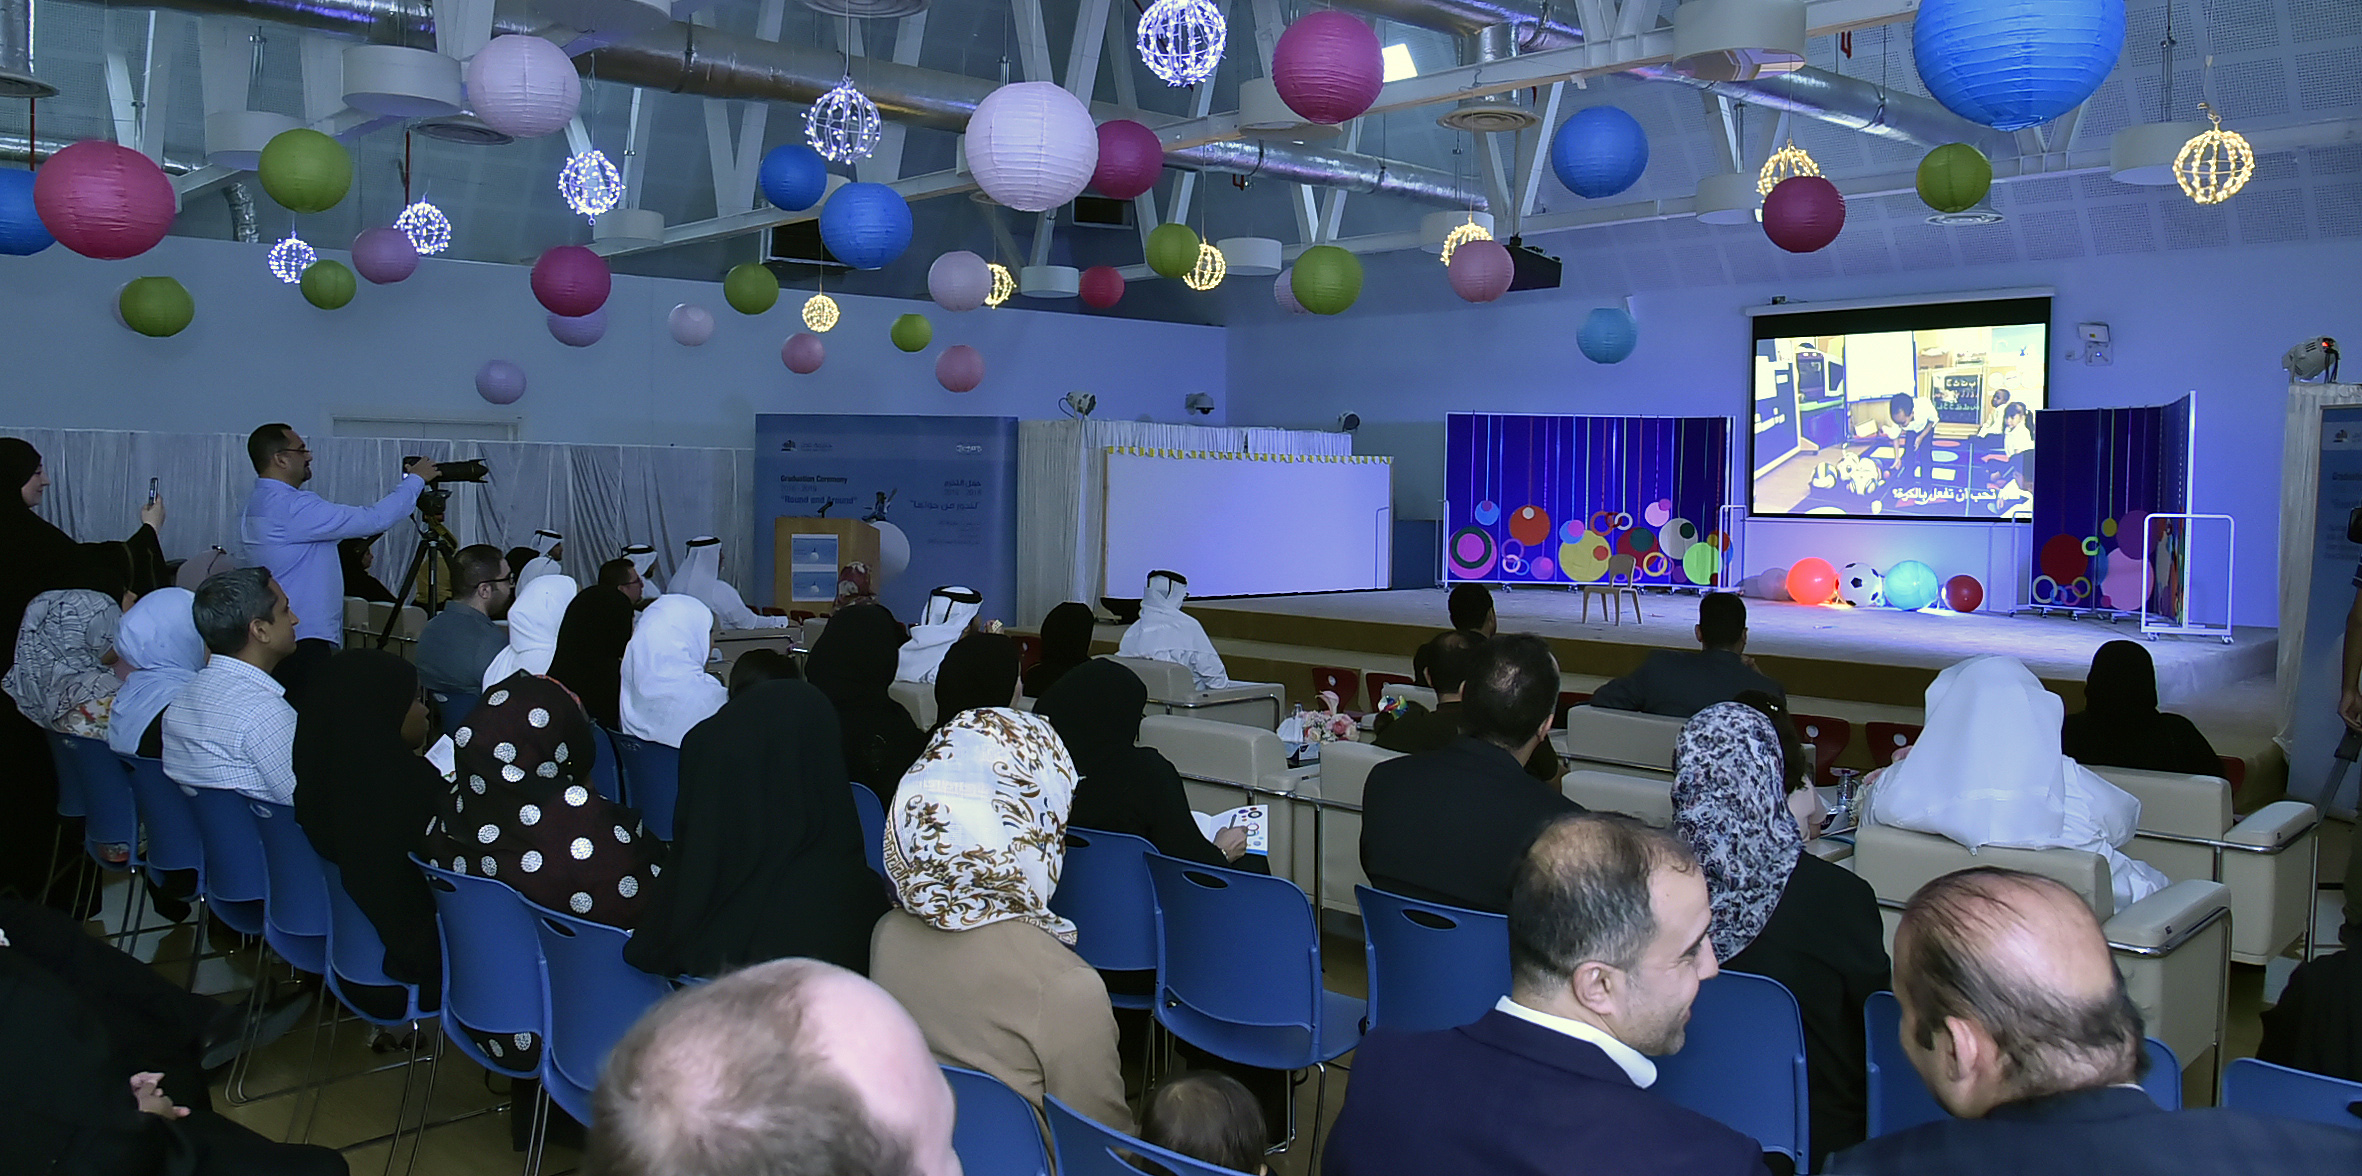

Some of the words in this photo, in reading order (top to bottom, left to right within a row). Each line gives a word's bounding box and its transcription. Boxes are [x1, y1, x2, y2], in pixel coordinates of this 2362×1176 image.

[780, 474, 815, 483] Graduation
[816, 475, 848, 485] Ceremony
[810, 496, 825, 504] and
[1970, 488, 1997, 503] تحب
